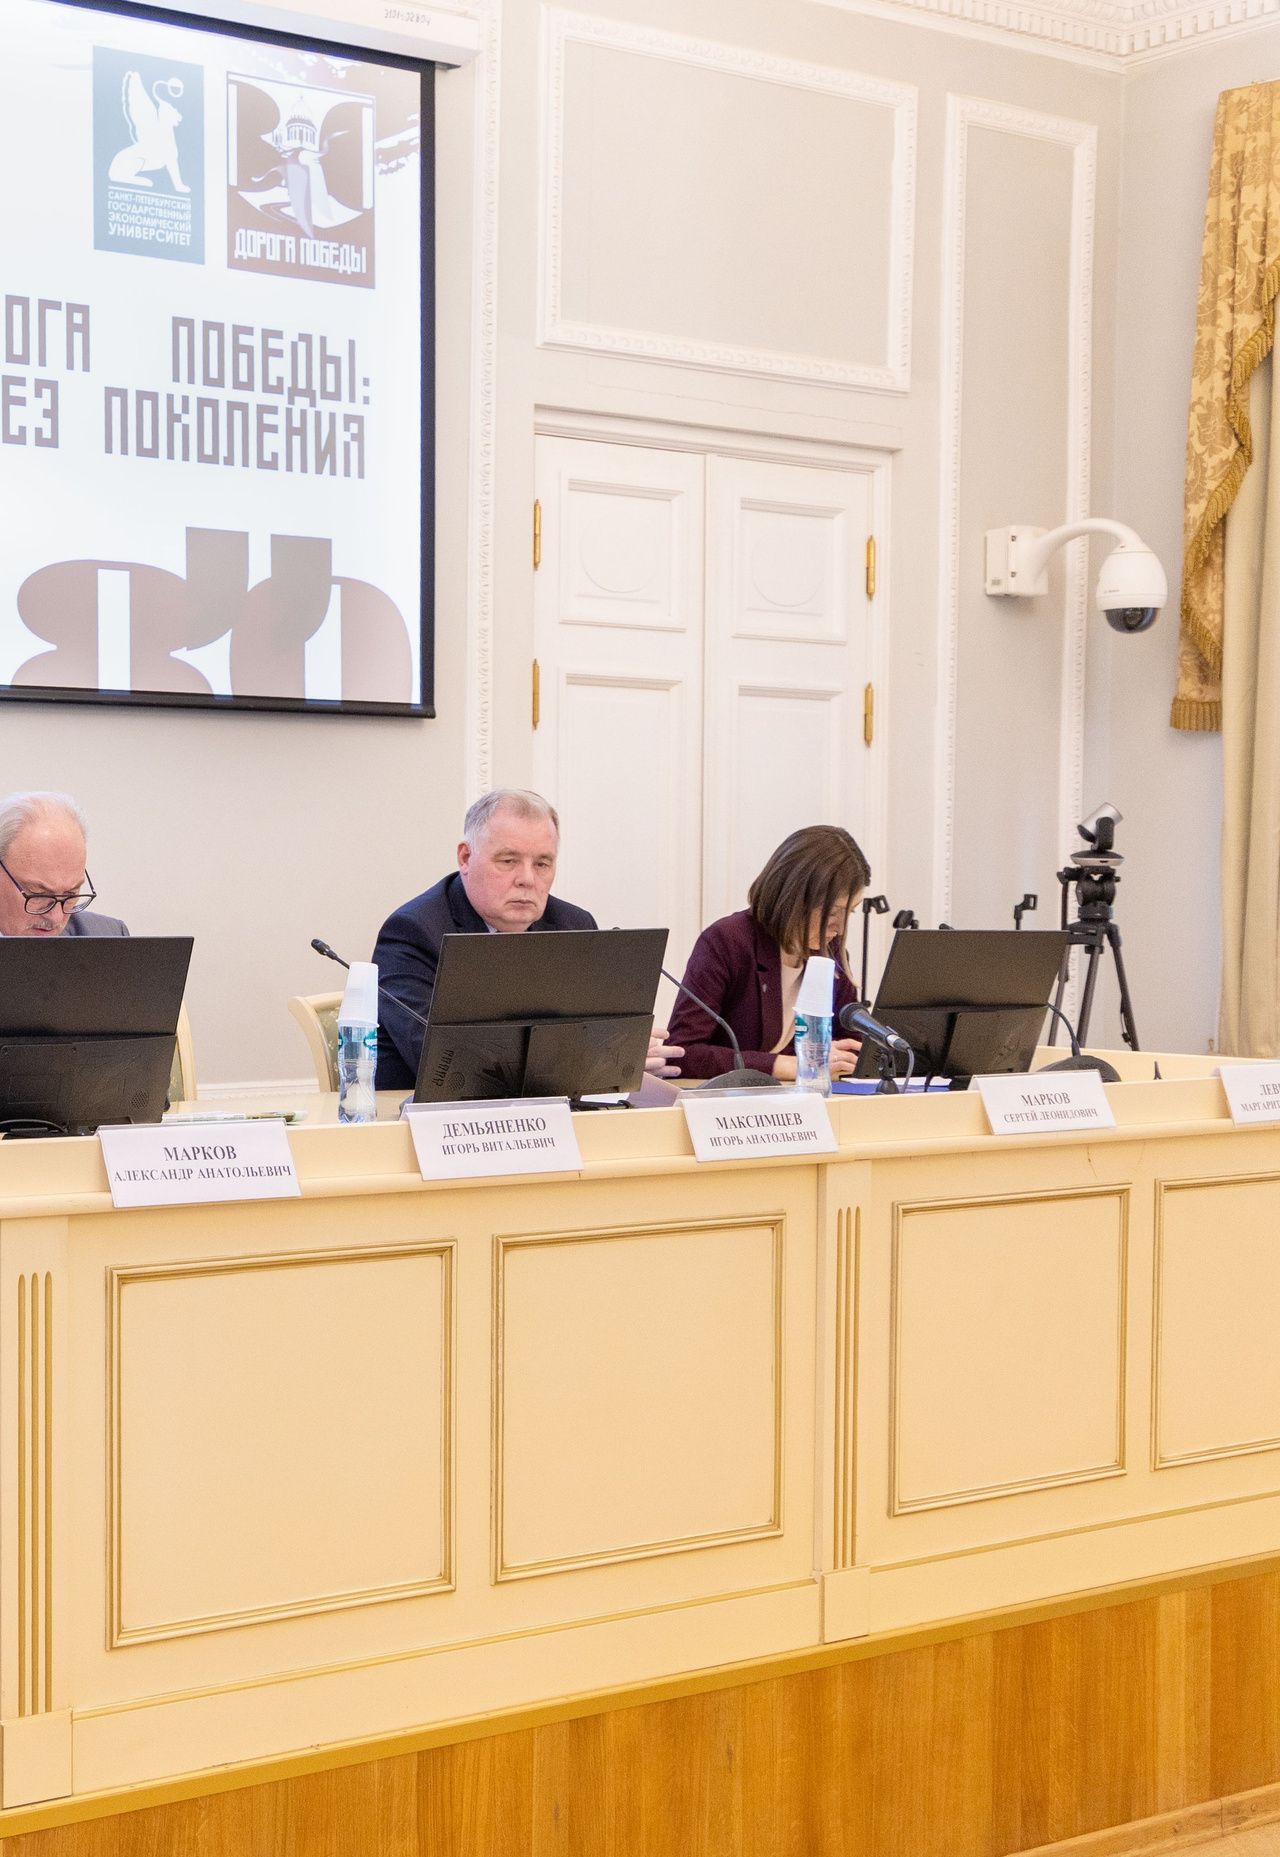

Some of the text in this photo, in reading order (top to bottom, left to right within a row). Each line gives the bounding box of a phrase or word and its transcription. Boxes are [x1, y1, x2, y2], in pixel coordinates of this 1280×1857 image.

[107, 200, 192, 222] ГОСУДАРСТВЕННЫЙ
[108, 190, 192, 211] САНКТ-ПЕТЕРБУРГСКИЙ
[108, 211, 192, 233] ЭКОНОМИЧЕСКИЙ
[108, 222, 192, 247] УНИВЕРСИТЕТ
[234, 227, 367, 276] ДОРОГА ПОБЕДЫ
[171, 316, 370, 408] ПОБЕДЫ:
[104, 386, 365, 480] ПОКОЛЕНИЯ
[1021, 1092, 1071, 1107] МАРКОВ
[715, 1112, 803, 1130] МАКСИМЦЕВ
[1003, 1108, 1099, 1123] СЕРГЕЙ ЛЕОНИДОВИЧ
[442, 1117, 547, 1140] ДЕМЬЯНЕНКО
[709, 1131, 818, 1147] ИГОРЬ АНАТОЛЬЕВИЧ
[163, 1145, 237, 1162] МАРКОВ
[442, 1137, 556, 1156] ИГОРЬ ВИТАЛЬЕВИЧ
[114, 1165, 292, 1182] АЛЕКСАНДР АНАТОЛЬЕВИЧ
